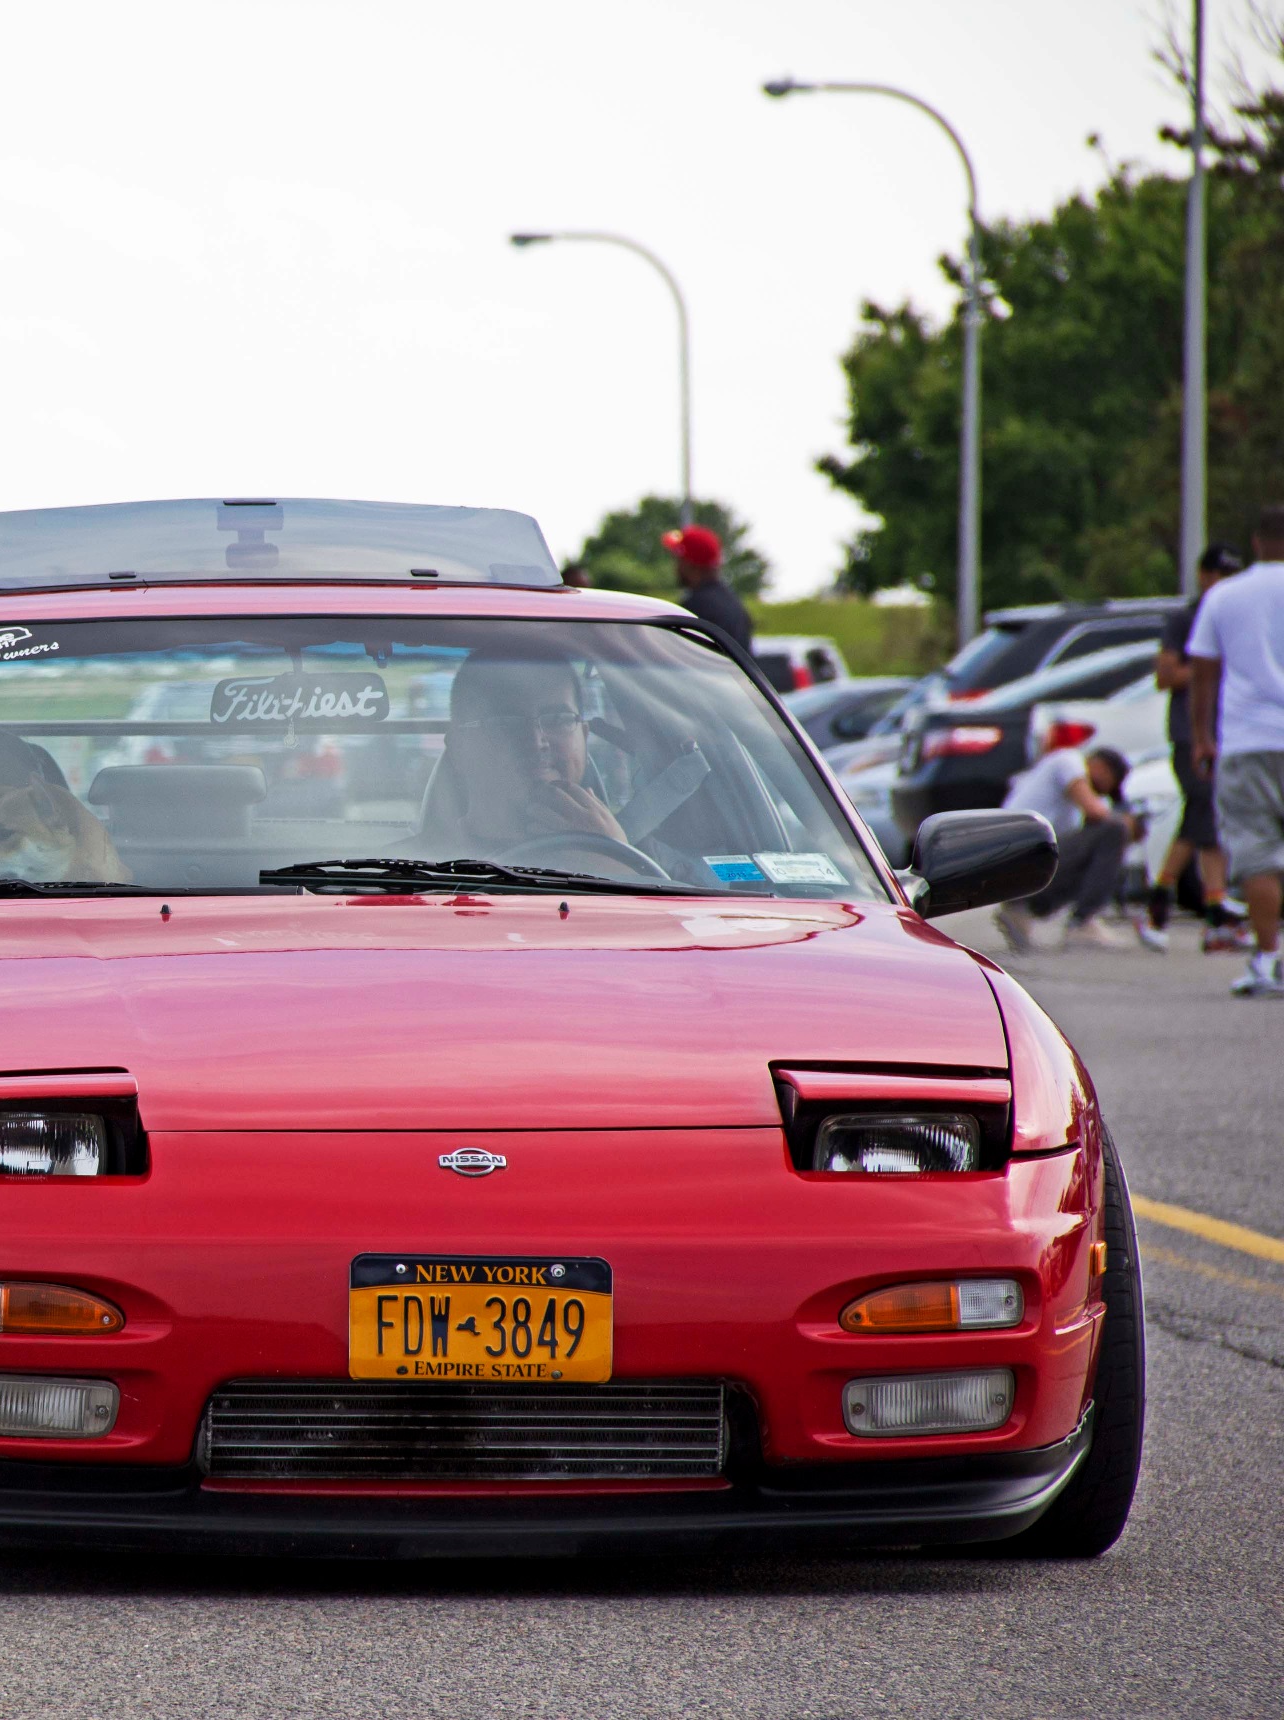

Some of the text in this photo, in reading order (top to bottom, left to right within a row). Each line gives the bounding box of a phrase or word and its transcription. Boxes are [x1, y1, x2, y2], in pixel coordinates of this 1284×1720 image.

[442, 1155, 503, 1164] NISSAN
[416, 1264, 548, 1285] NEW YORK
[377, 1294, 585, 1359] FDW 3849
[414, 1360, 548, 1379] EMPIRE STATE
